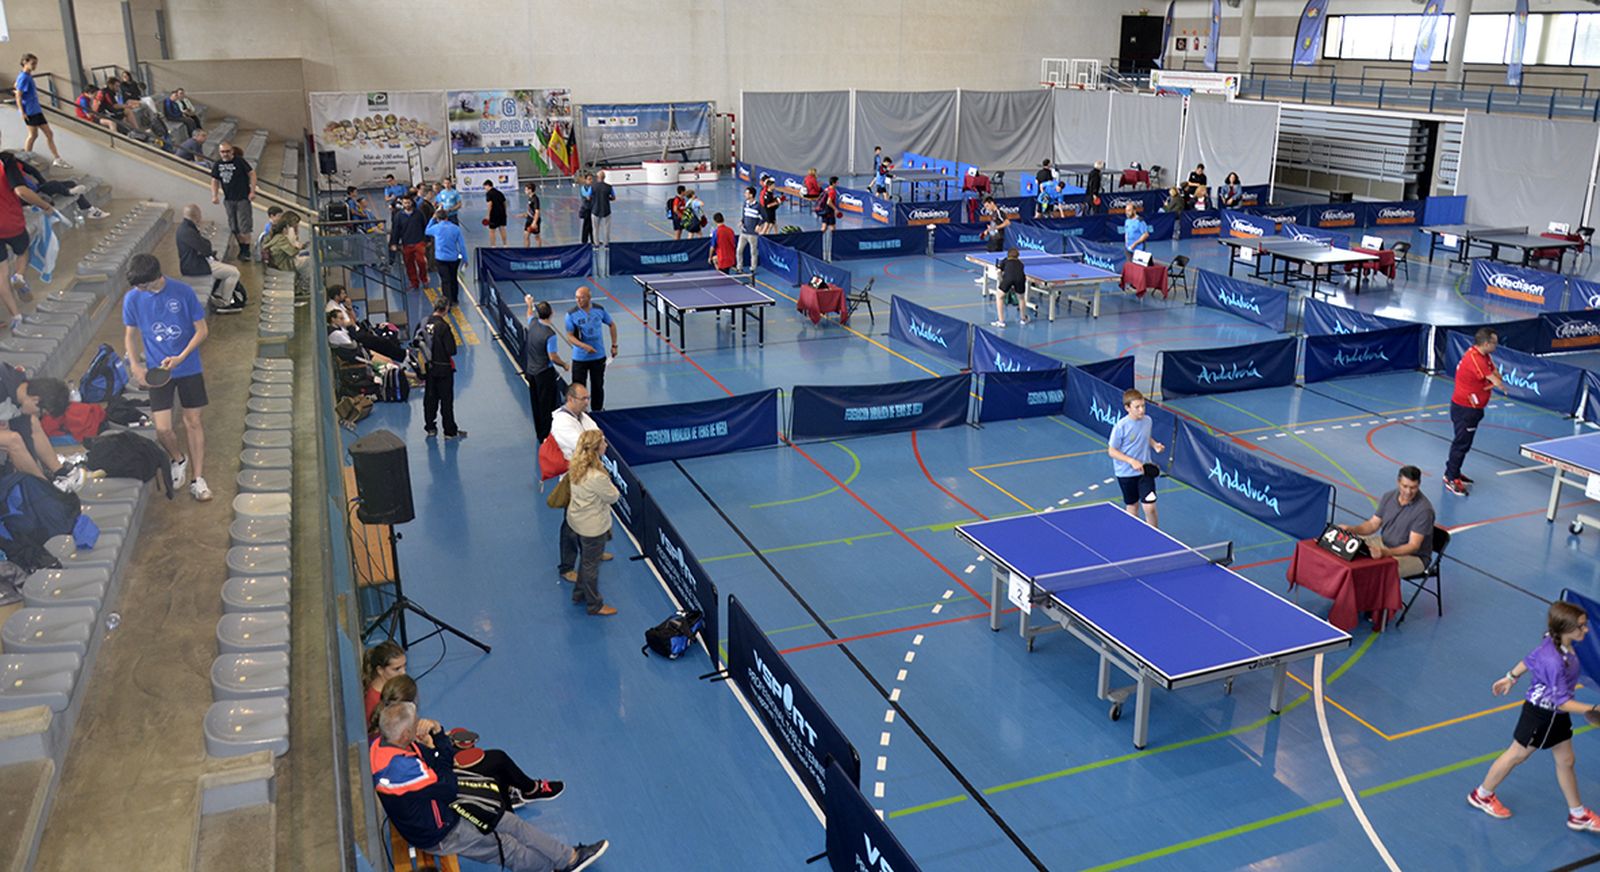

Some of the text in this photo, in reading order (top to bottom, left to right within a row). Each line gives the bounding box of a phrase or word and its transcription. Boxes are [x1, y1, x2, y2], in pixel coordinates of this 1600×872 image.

[1490, 274, 1545, 296] Madison
[1196, 361, 1263, 385] Andalucía
[1208, 457, 1281, 517] Andalucía
[1324, 529, 1338, 543] 4
[1345, 538, 1359, 553] 0
[1016, 588, 1023, 601] 2
